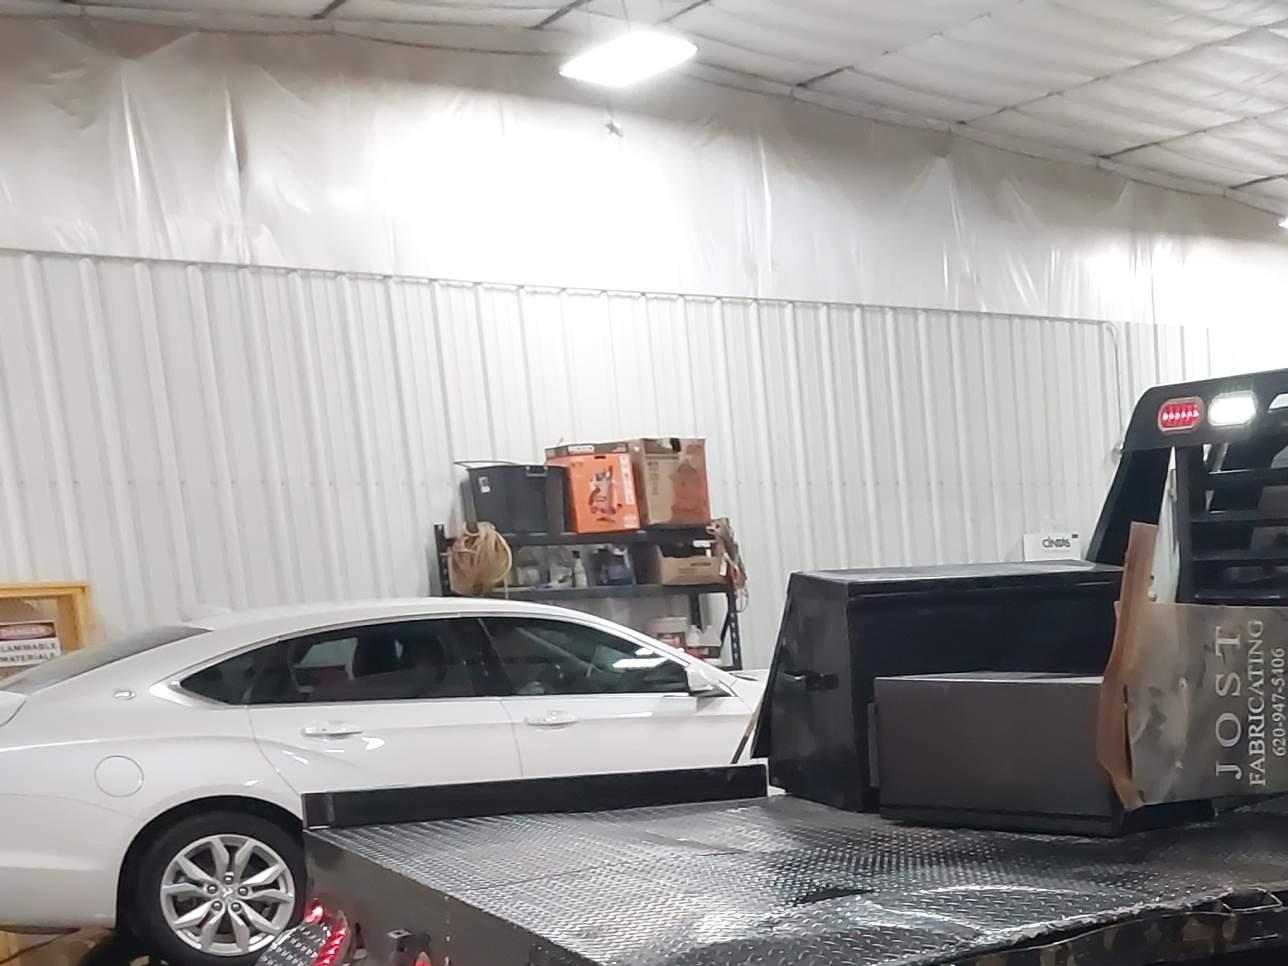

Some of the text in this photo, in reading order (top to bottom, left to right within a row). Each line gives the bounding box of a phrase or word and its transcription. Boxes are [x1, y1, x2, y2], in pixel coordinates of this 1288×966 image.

[0, 642, 56, 653] LAMMABLE
[1215, 625, 1242, 780] JOST
[1247, 619, 1267, 787] FABRICATING
[1271, 647, 1287, 757] 620-947-5406
